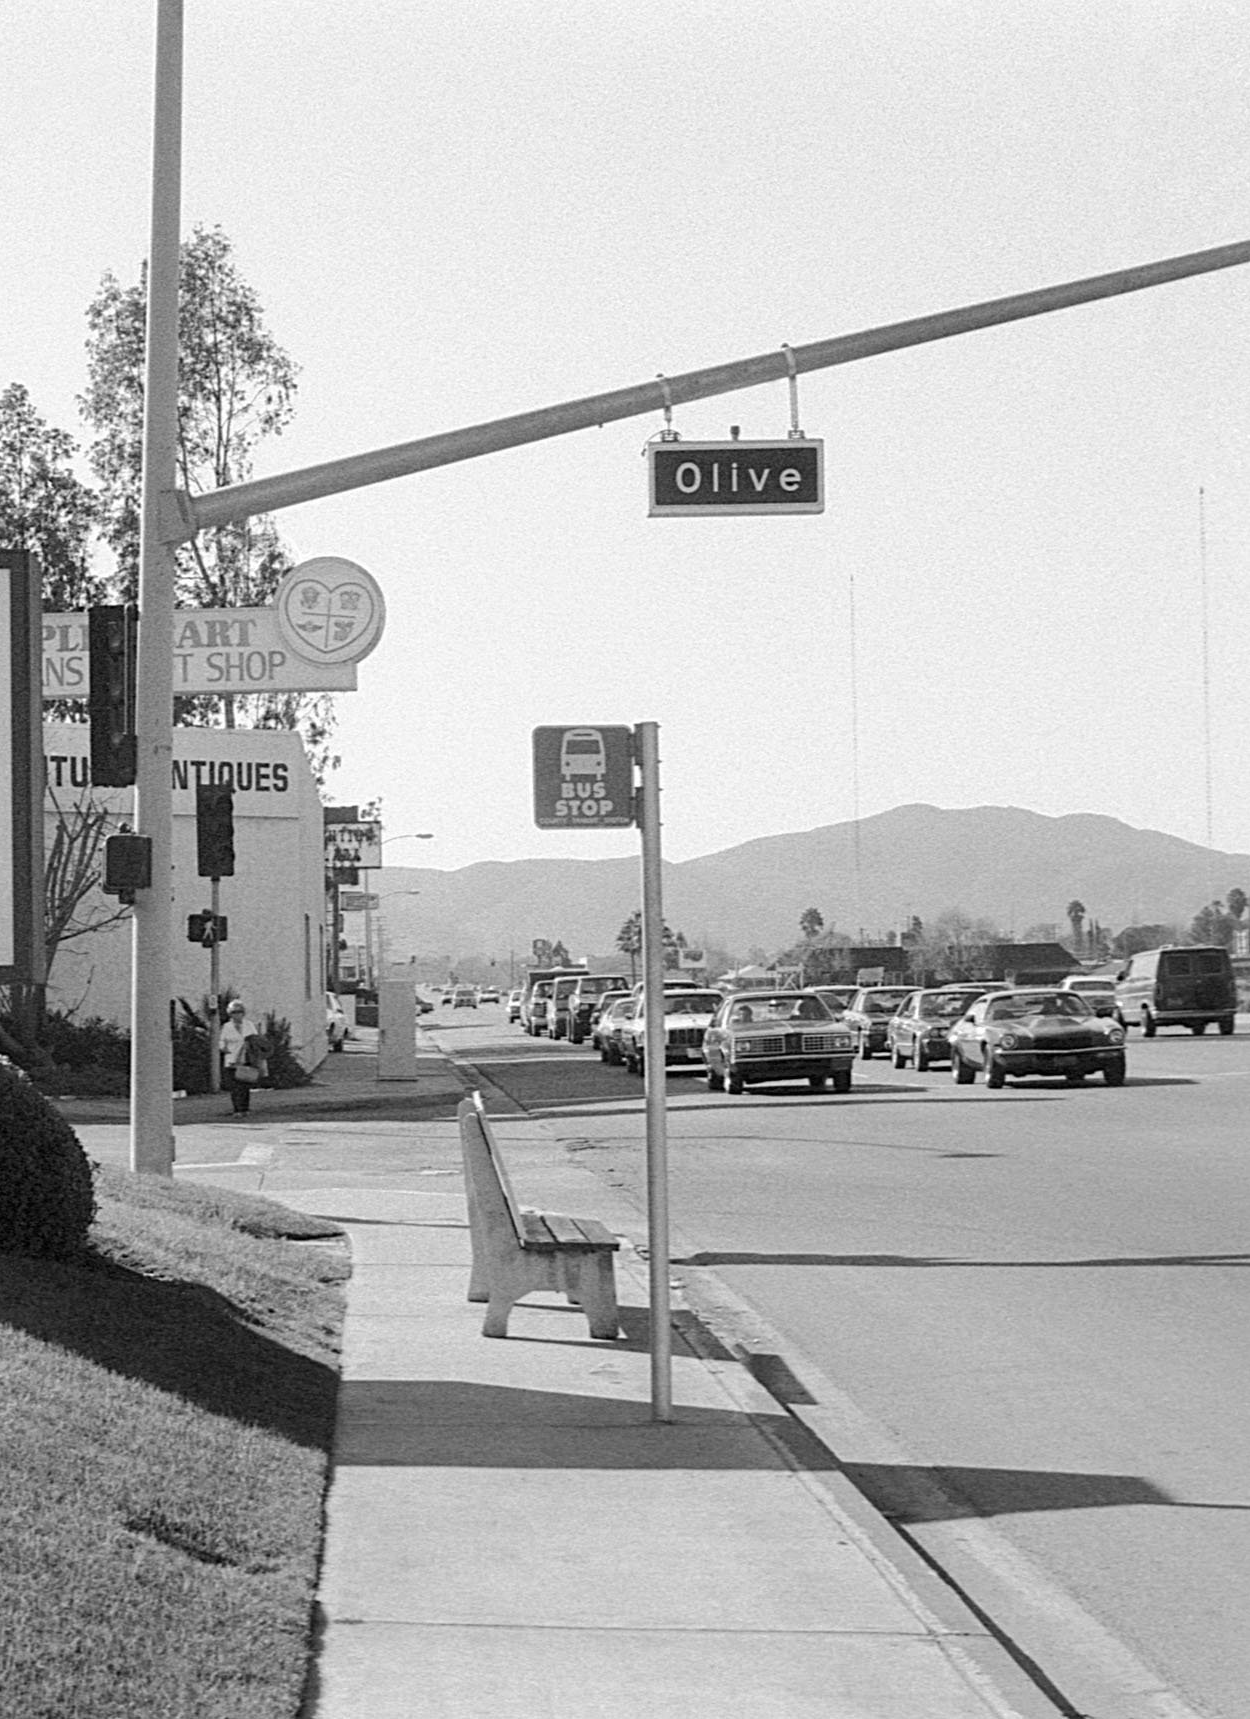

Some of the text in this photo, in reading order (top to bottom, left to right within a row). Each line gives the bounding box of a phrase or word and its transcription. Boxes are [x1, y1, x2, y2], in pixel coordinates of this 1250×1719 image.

[675, 462, 802, 494] Olive
[173, 618, 258, 649] ART
[206, 650, 287, 683] SHOP
[45, 755, 89, 788] TU
[561, 781, 607, 799] BUS
[554, 799, 613, 817] STOP
